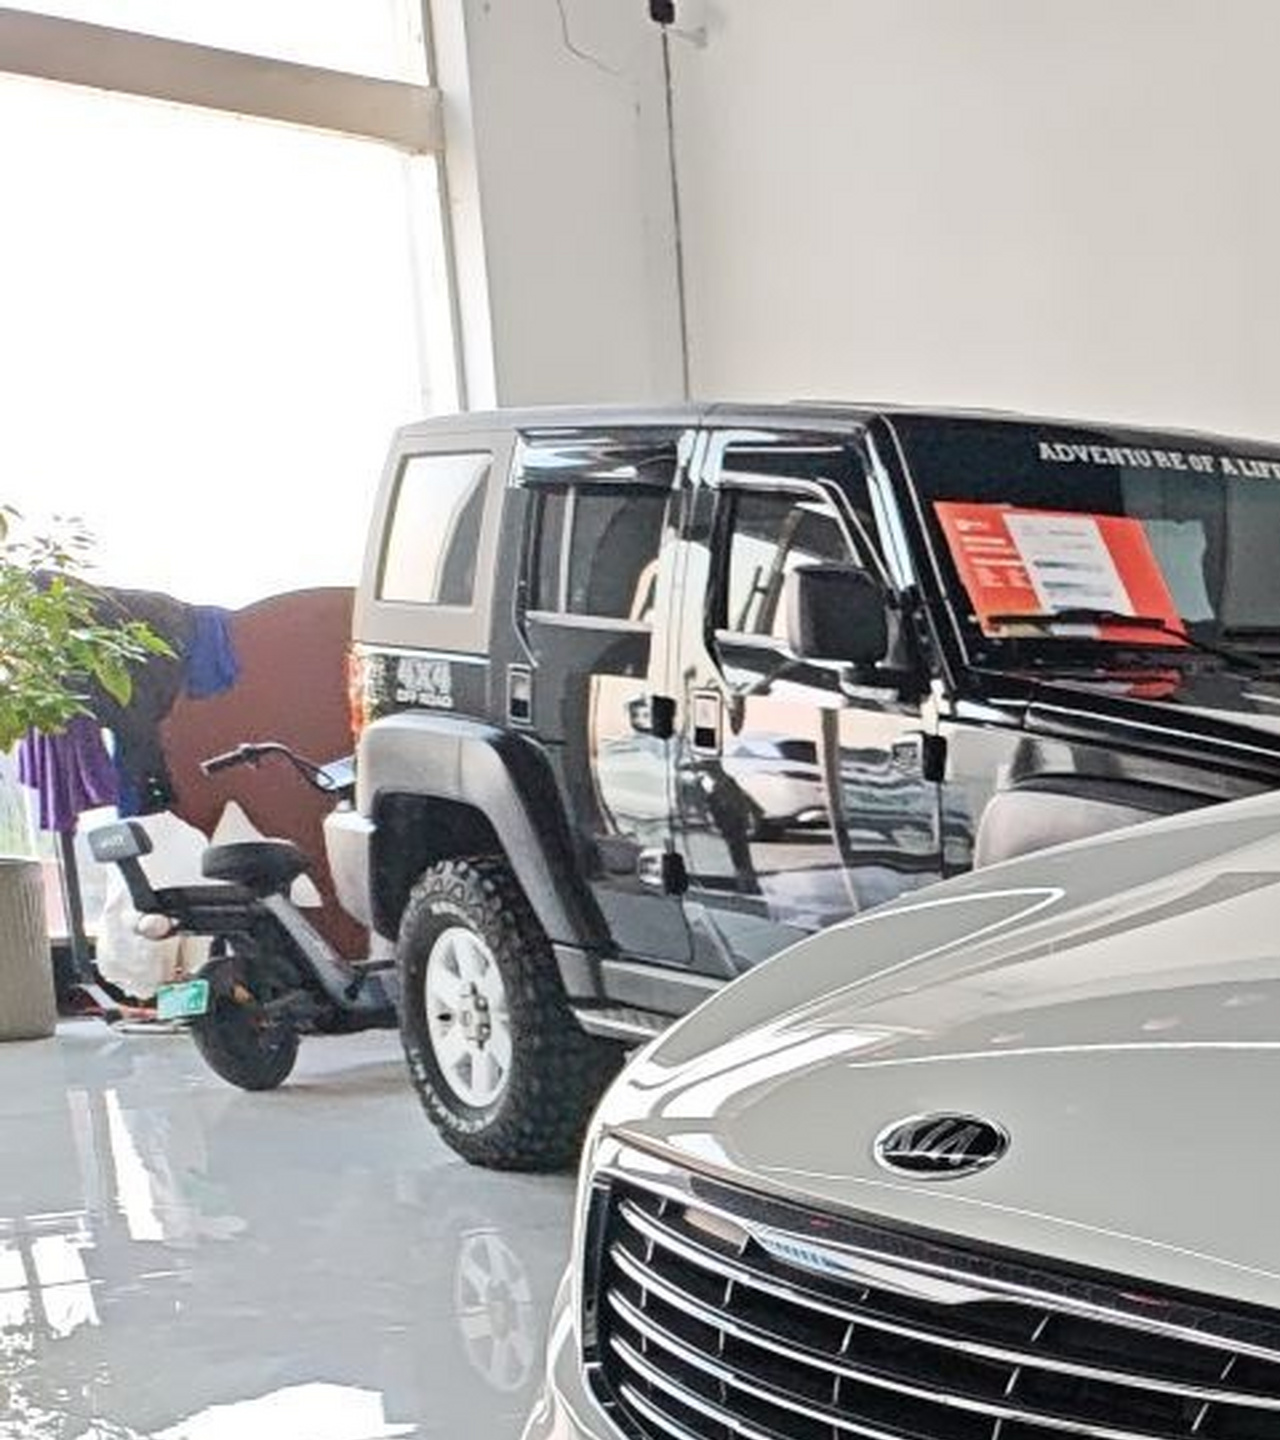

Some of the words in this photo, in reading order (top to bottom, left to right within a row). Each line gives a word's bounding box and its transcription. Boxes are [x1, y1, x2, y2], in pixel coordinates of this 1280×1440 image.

[1038, 441, 1188, 470] ADVENTURE
[1190, 455, 1217, 473] OF
[1220, 457, 1238, 476] A
